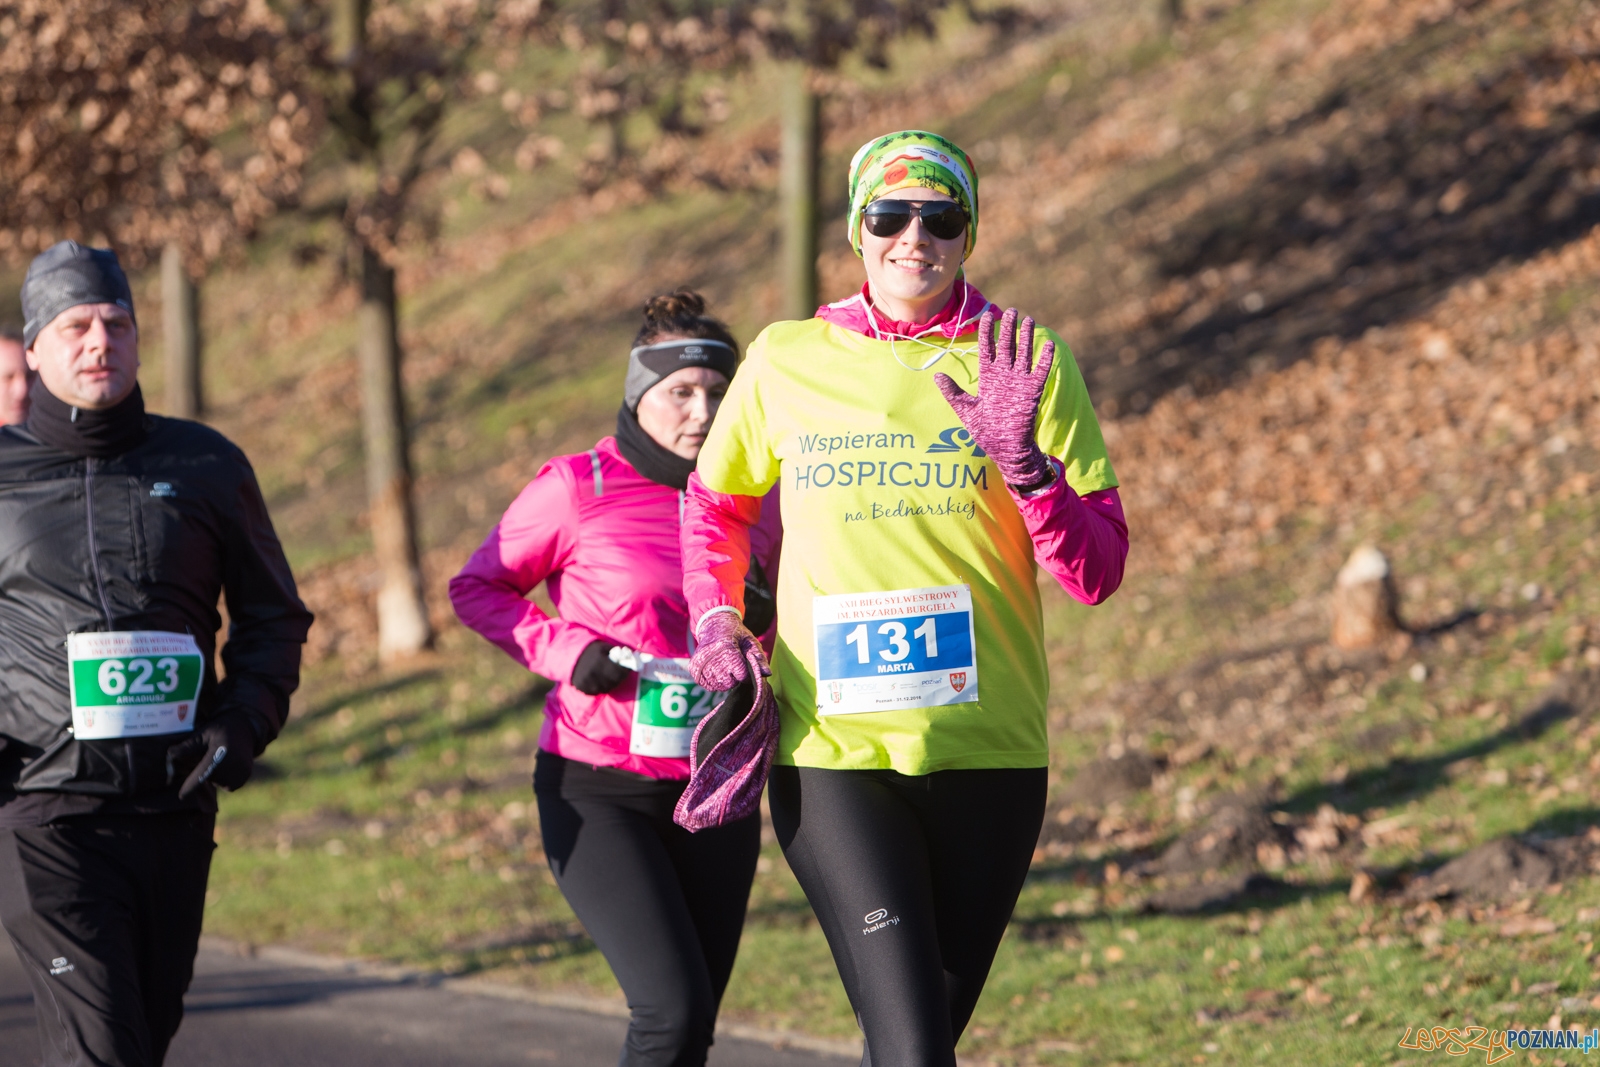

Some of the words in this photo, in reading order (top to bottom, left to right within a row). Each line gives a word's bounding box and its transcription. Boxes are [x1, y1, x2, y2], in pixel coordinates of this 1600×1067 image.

[798, 431, 915, 455] Wspieram
[795, 461, 989, 491] HOSPICJUM
[844, 510, 867, 522] na
[870, 496, 976, 520] Bednarskiej
[853, 607, 904, 619] RYSZARDA
[906, 601, 956, 614] BURGIELA
[860, 597, 883, 607] BIEG
[884, 590, 959, 605] SYLWESTROWY
[845, 617, 939, 664] 131
[97, 657, 179, 696] 623
[877, 662, 915, 674] MARTA
[116, 694, 166, 705] ARKADIUSZ
[660, 684, 729, 719] 62
[862, 915, 900, 936] Kalenji
